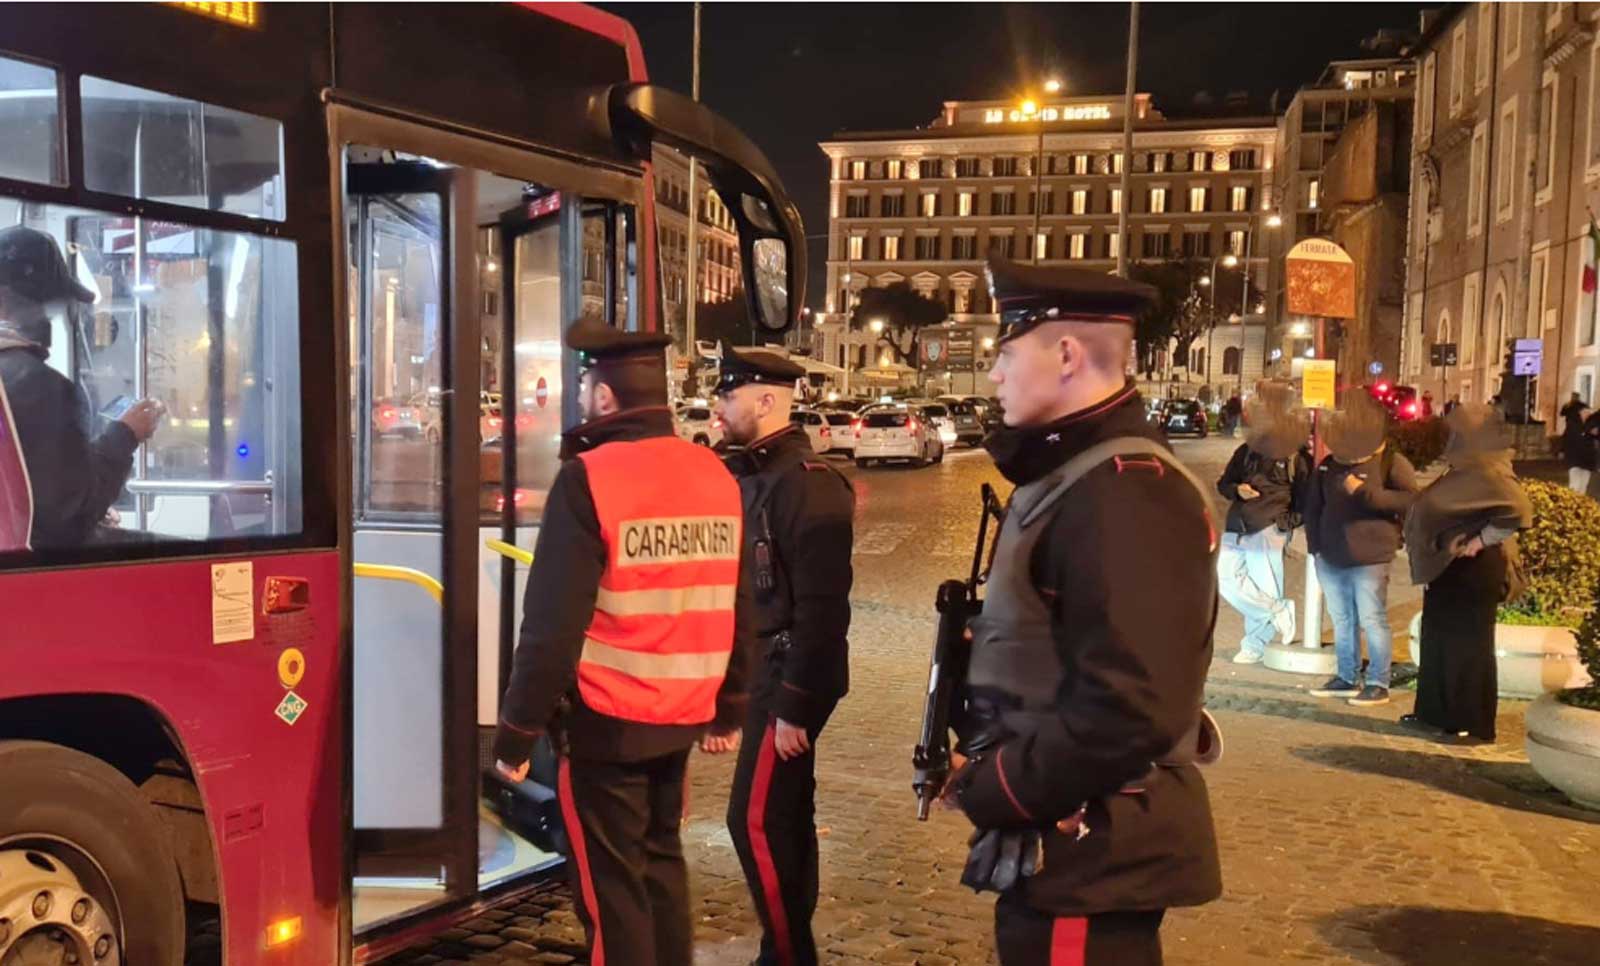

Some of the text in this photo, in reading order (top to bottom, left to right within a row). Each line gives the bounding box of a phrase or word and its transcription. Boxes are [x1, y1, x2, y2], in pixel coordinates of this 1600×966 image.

[1009, 106, 1058, 122] GRND
[1063, 104, 1111, 121] HOTEL
[1300, 243, 1338, 256] FERMATA
[624, 521, 736, 558] CARABINIERI
